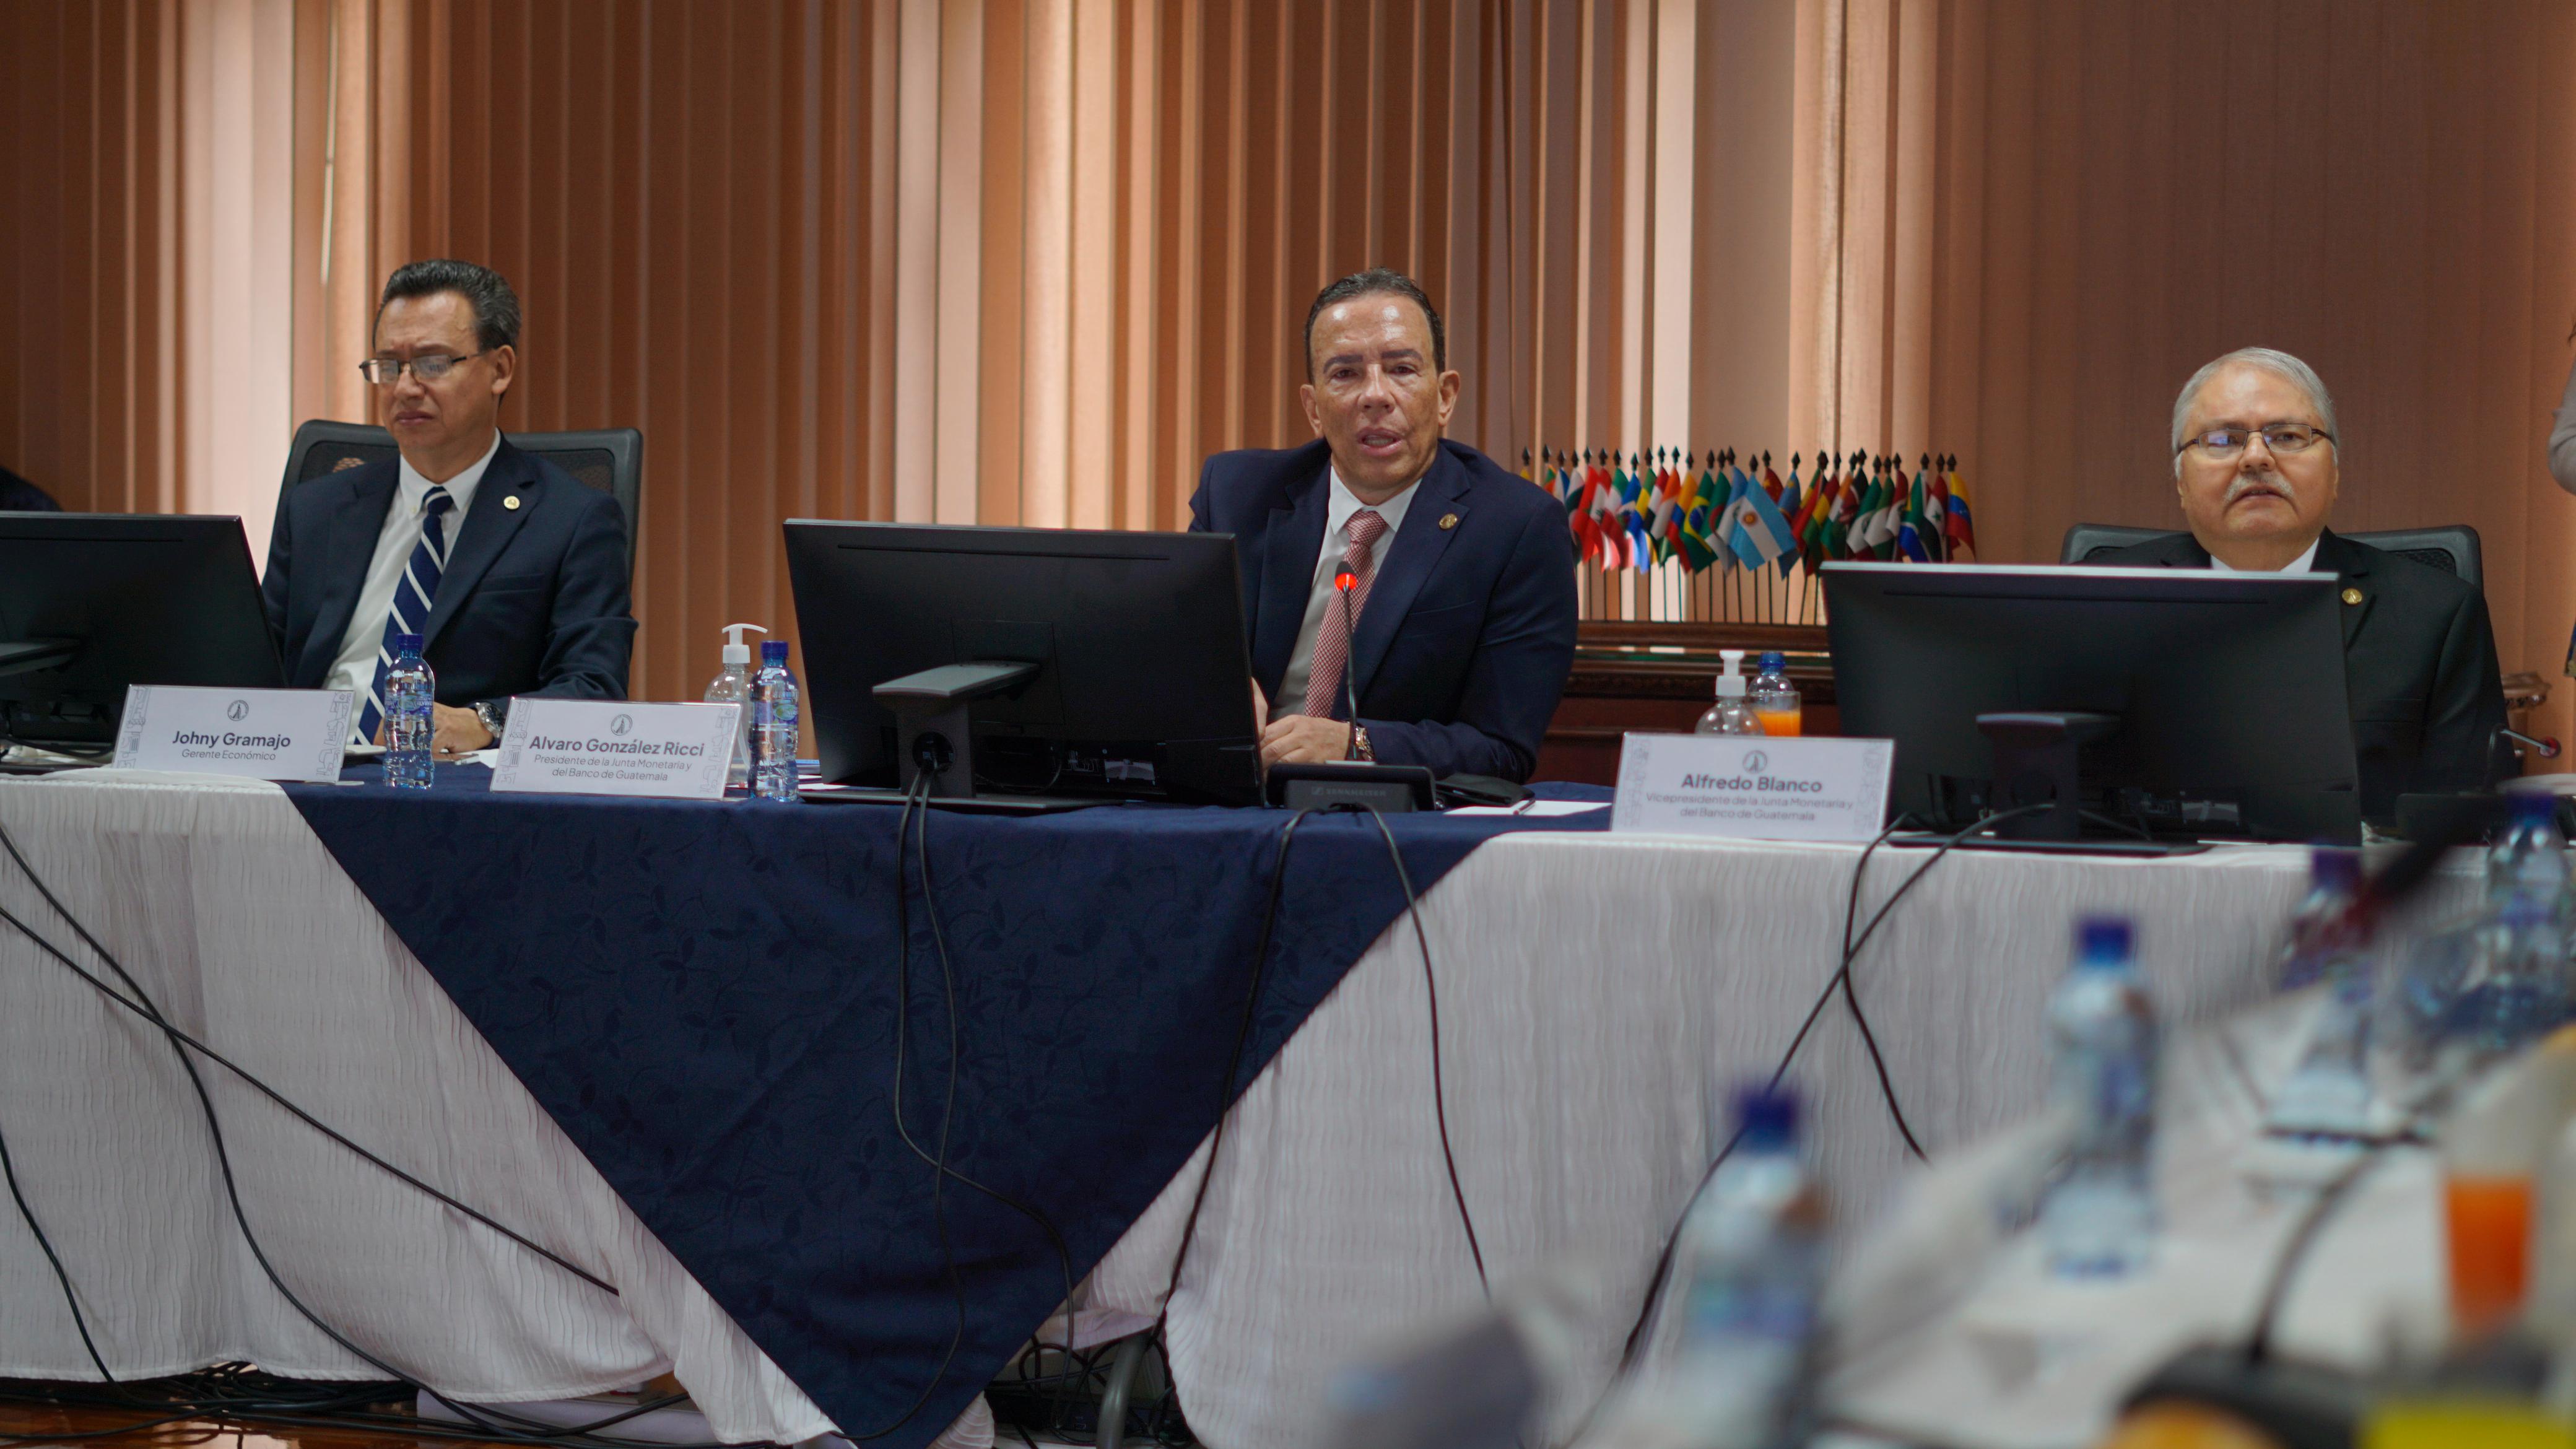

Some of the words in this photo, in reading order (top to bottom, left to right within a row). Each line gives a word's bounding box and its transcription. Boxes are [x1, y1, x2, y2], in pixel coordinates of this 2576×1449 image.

[172, 731, 219, 749] Johny
[223, 733, 290, 751] Gramajo
[529, 736, 582, 751] Alvaro
[586, 739, 661, 754] González
[663, 742, 705, 756] Ricci
[182, 749, 220, 759] Gerente
[222, 750, 276, 760] Económico
[534, 754, 586, 765] Presidente
[588, 757, 601, 766] de
[601, 757, 610, 767] la
[611, 758, 635, 767] Junta
[637, 759, 685, 769] Monetaria
[685, 762, 692, 772] y
[552, 768, 568, 777] del
[569, 768, 599, 778] Banco
[601, 770, 614, 778] de
[616, 770, 668, 781] Guatemala
[1682, 773, 1752, 790] Alfredo
[1757, 776, 1822, 793] Blanco
[1646, 793, 1730, 805] Vicepresidente
[1731, 795, 1747, 806] de
[1749, 796, 1758, 806] la
[1760, 796, 1788, 807] Junta
[1790, 798, 1845, 809] Monetaria
[1845, 801, 1853, 811] y
[1680, 807, 1698, 817] del
[1699, 807, 1735, 818] Banco
[1736, 809, 1752, 819] de
[1754, 809, 1816, 821] Guatemala
